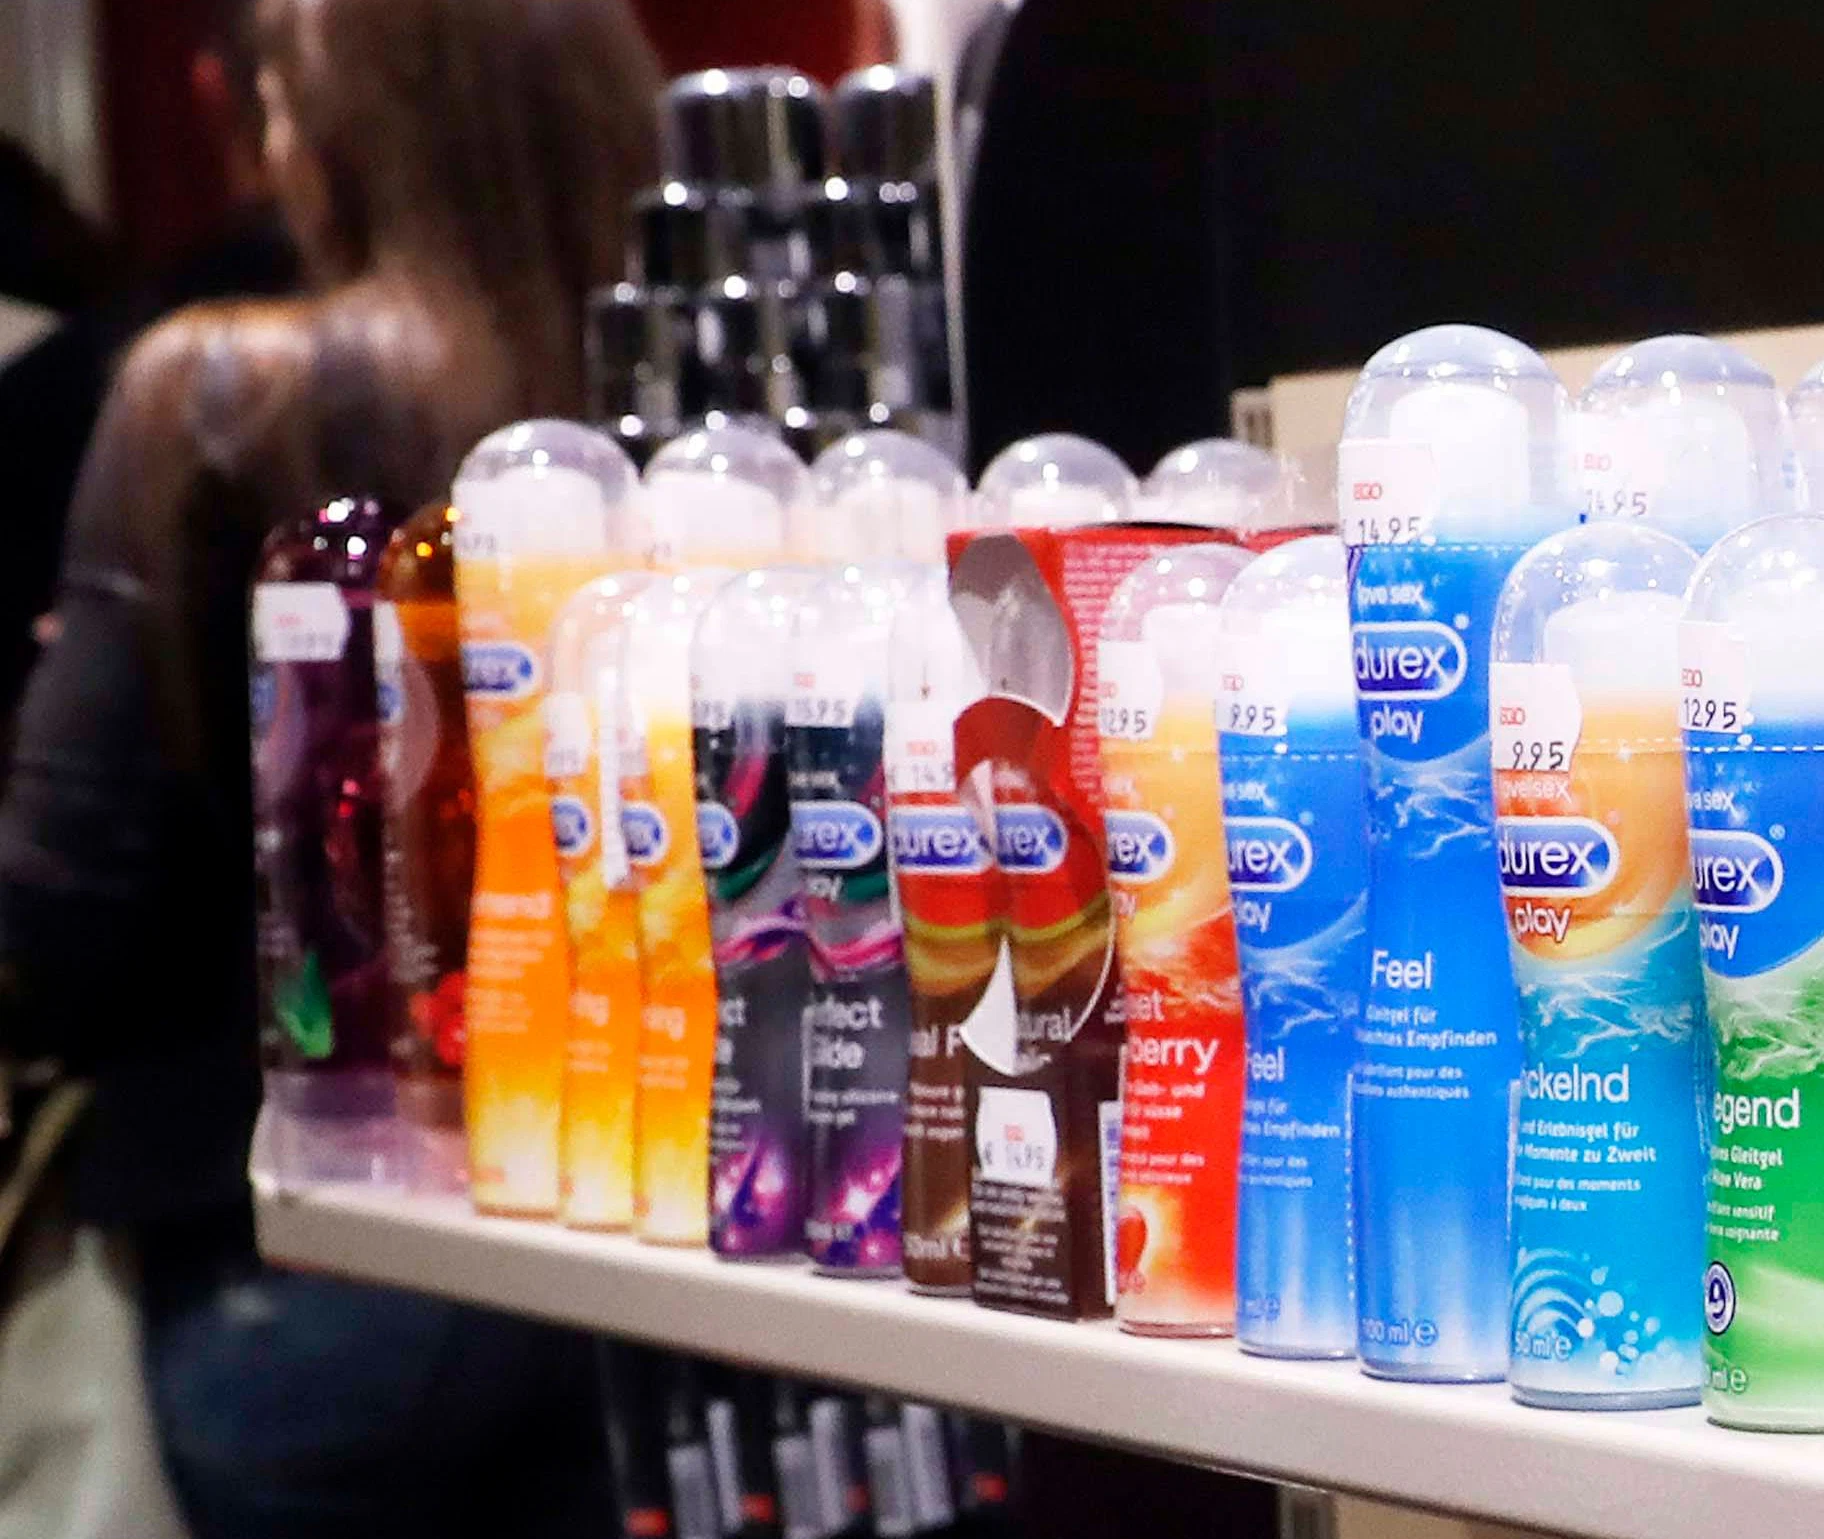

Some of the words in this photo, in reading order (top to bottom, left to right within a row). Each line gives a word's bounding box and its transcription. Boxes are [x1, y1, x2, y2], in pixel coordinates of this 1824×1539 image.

[1355, 635, 1450, 681] durex
[1370, 704, 1423, 744] play
[1512, 741, 1564, 770] 9.95
[1532, 778, 1571, 804] sex
[1500, 831, 1600, 877] durex
[1514, 901, 1570, 944] play
[1371, 950, 1434, 990] Feel
[1408, 1030, 1498, 1049] Empfinden
[1521, 1063, 1630, 1103] ckelnd
[1715, 1087, 1800, 1134] egend
[1613, 1120, 1639, 1141] für
[1583, 1148, 1601, 1162] zu
[1607, 1146, 1657, 1163] Zweit
[1730, 1144, 1784, 1170] Gleitgel
[1578, 1178, 1642, 1192] moments
[1734, 1172, 1763, 1190] Vera
